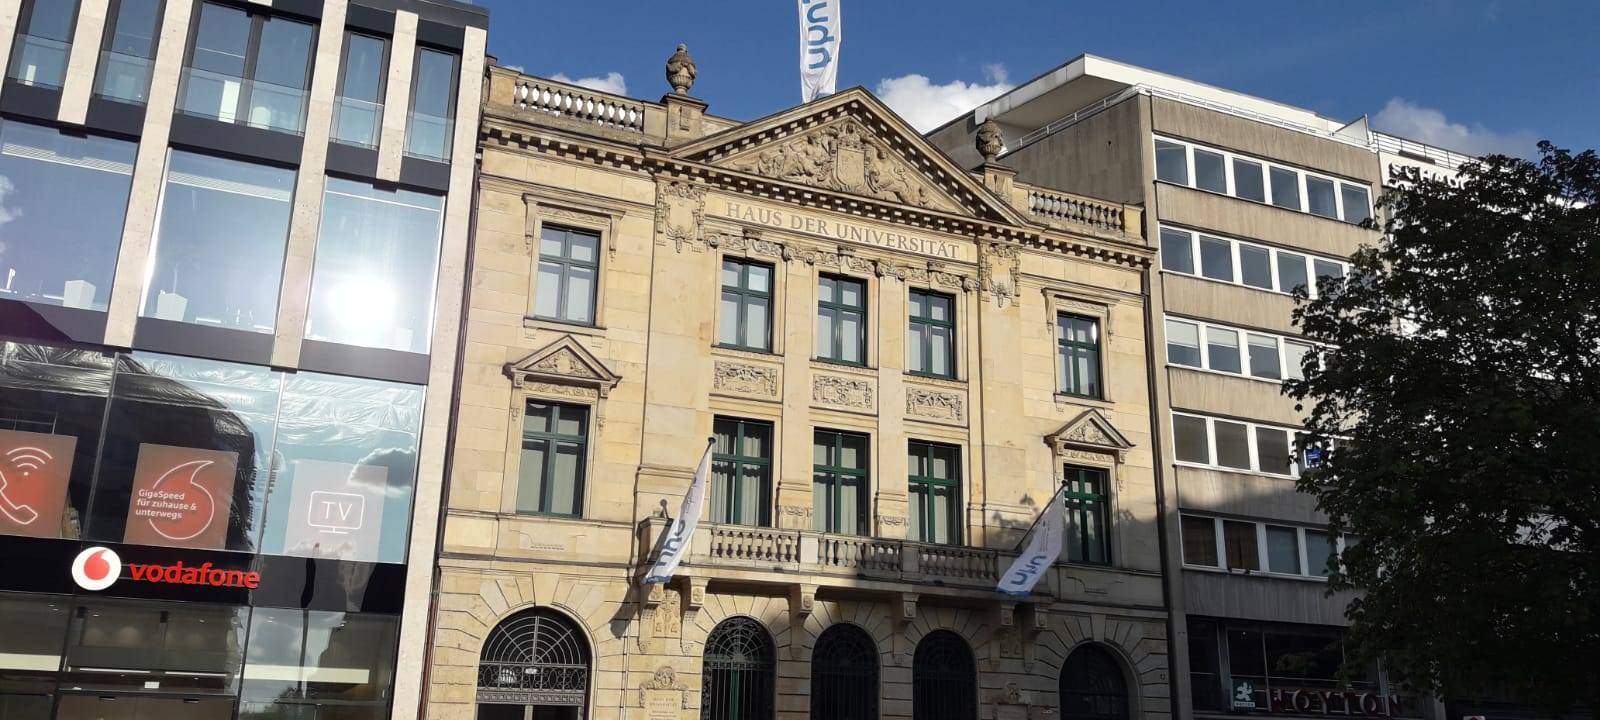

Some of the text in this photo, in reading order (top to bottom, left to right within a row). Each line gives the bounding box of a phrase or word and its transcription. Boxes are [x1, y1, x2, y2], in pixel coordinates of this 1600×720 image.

[727, 202, 959, 258] HAUS DER UNIVERSITÄT
[138, 489, 185, 501] GigaSpeed
[137, 498, 197, 511] für zuhause &
[320, 501, 352, 521] TV
[135, 509, 183, 520] unterwegs
[129, 560, 261, 589] vodafone
